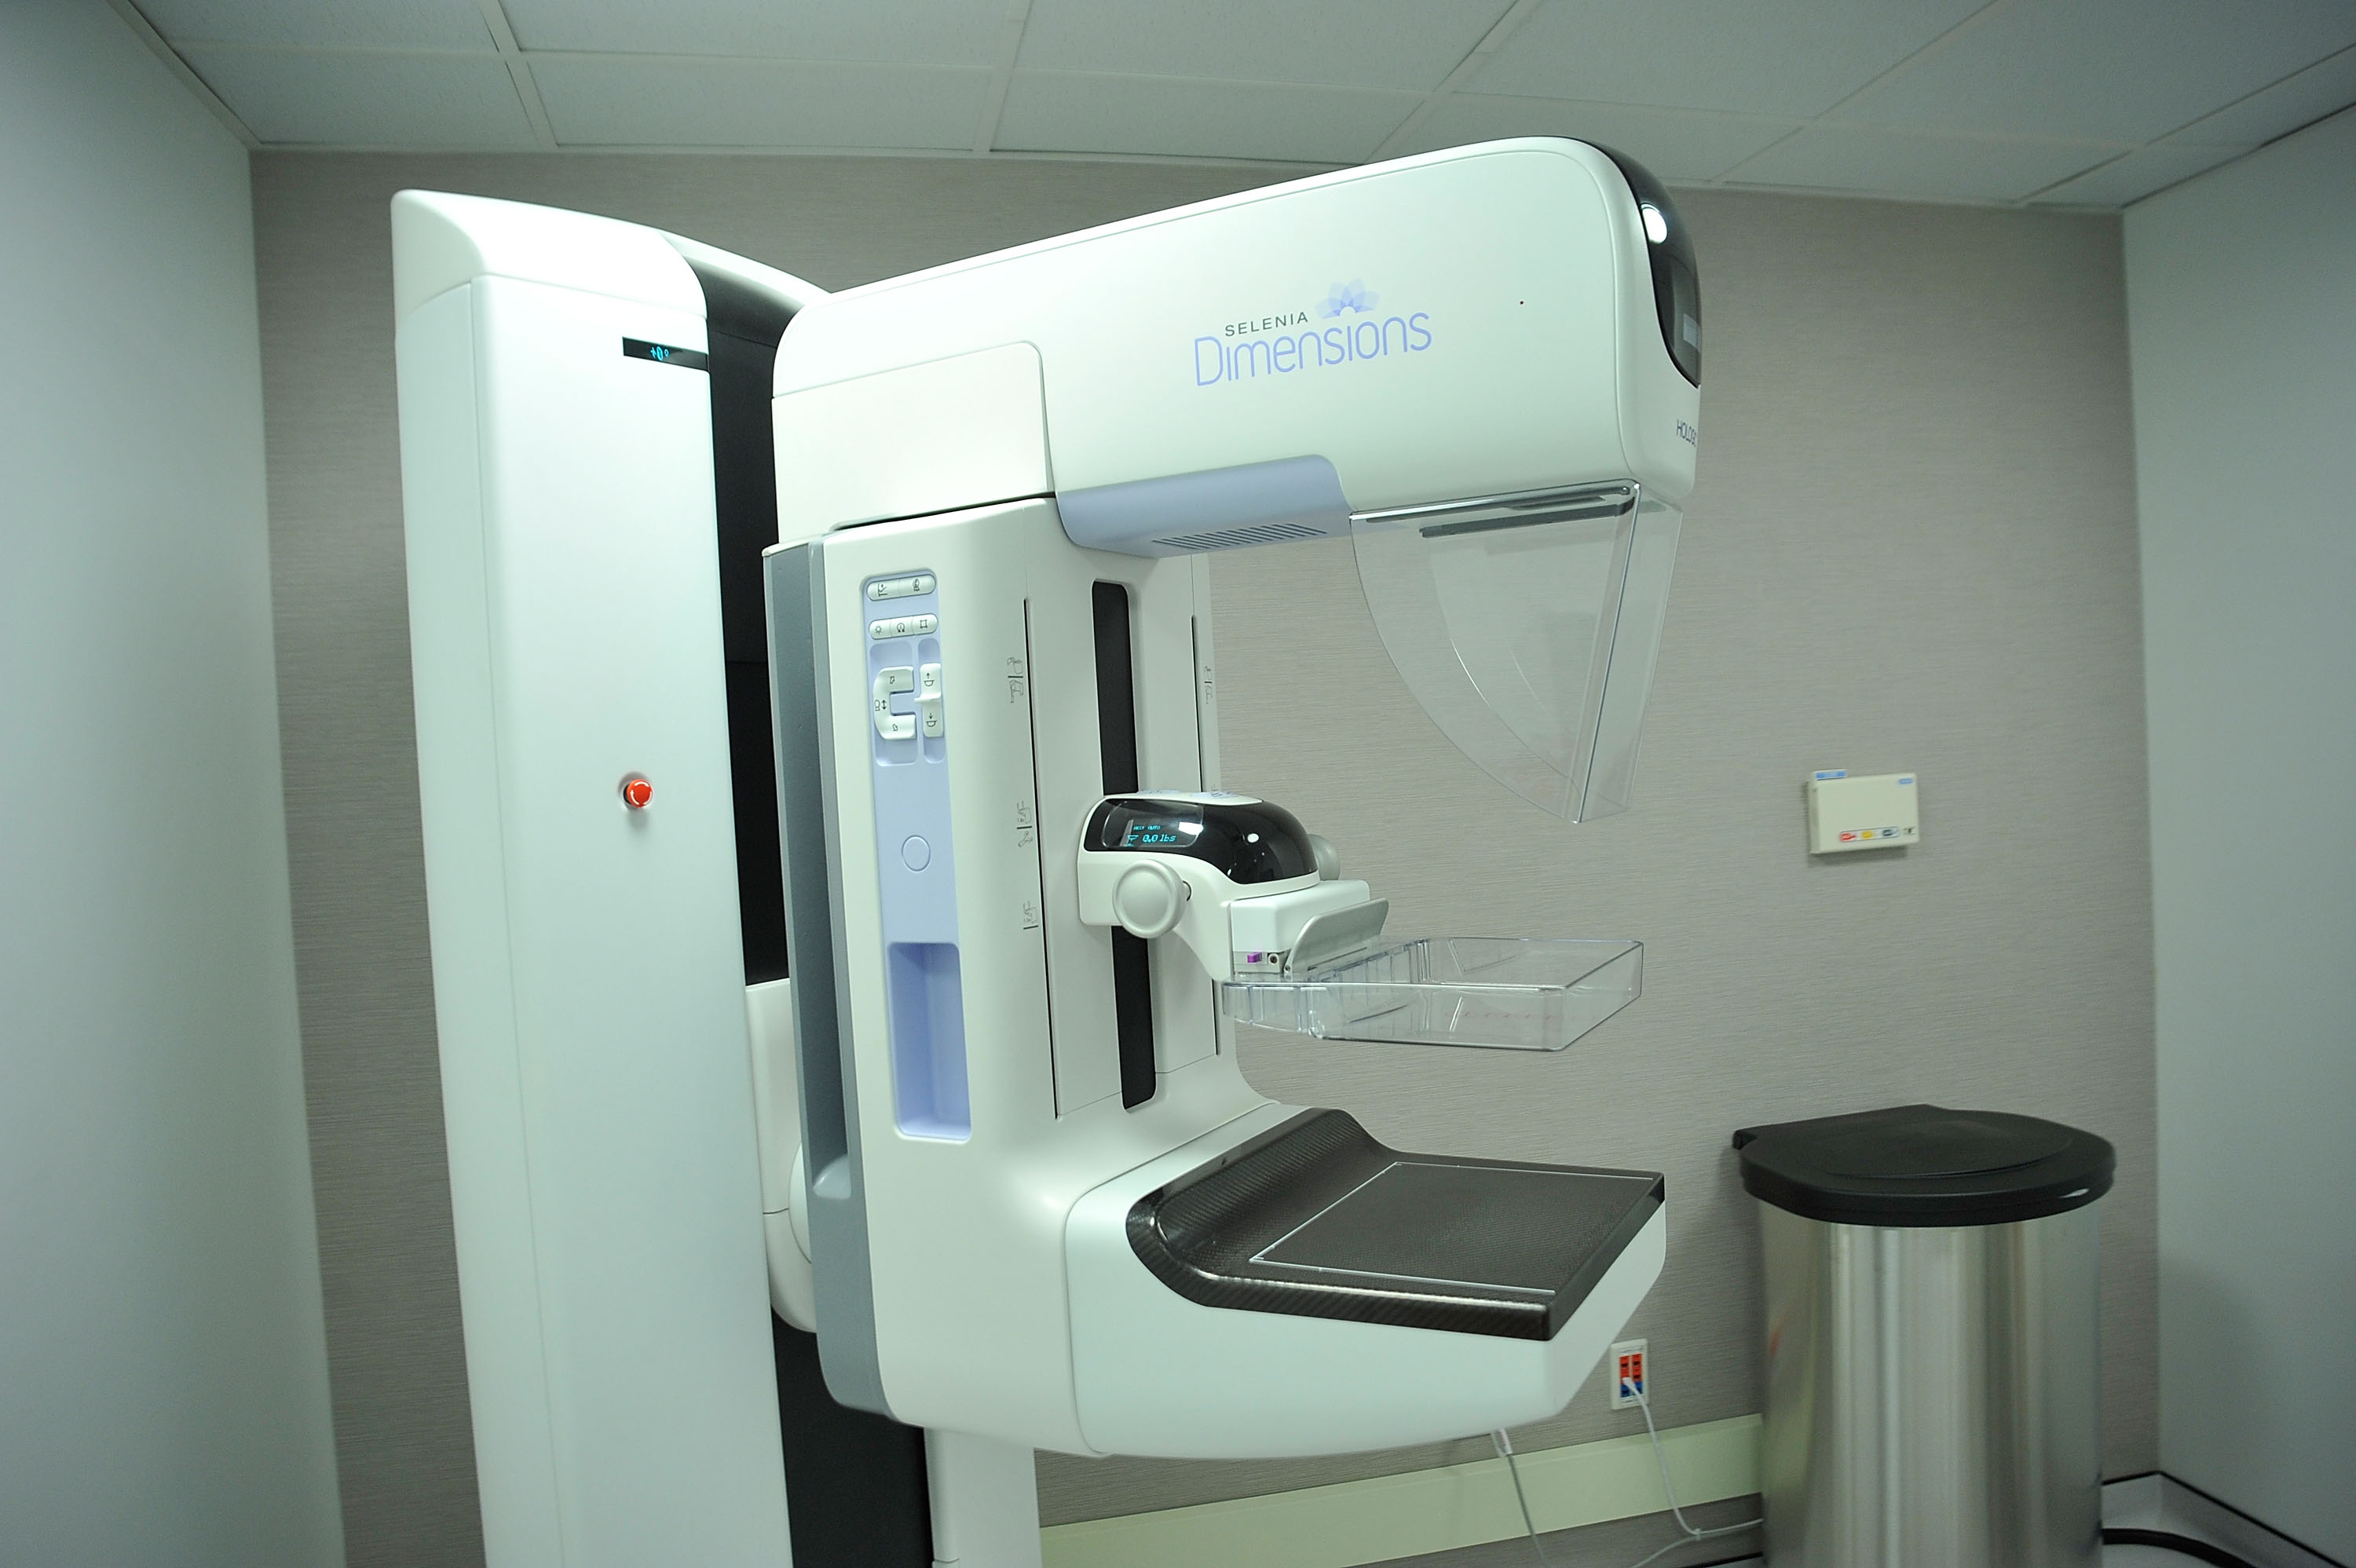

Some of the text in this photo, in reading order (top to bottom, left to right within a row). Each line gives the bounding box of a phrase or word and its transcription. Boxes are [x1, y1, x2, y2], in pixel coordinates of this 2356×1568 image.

[1224, 311, 1309, 337] SELENIA
[1194, 312, 1432, 387] Dimensions
[1143, 834, 1158, 842] 0.0
